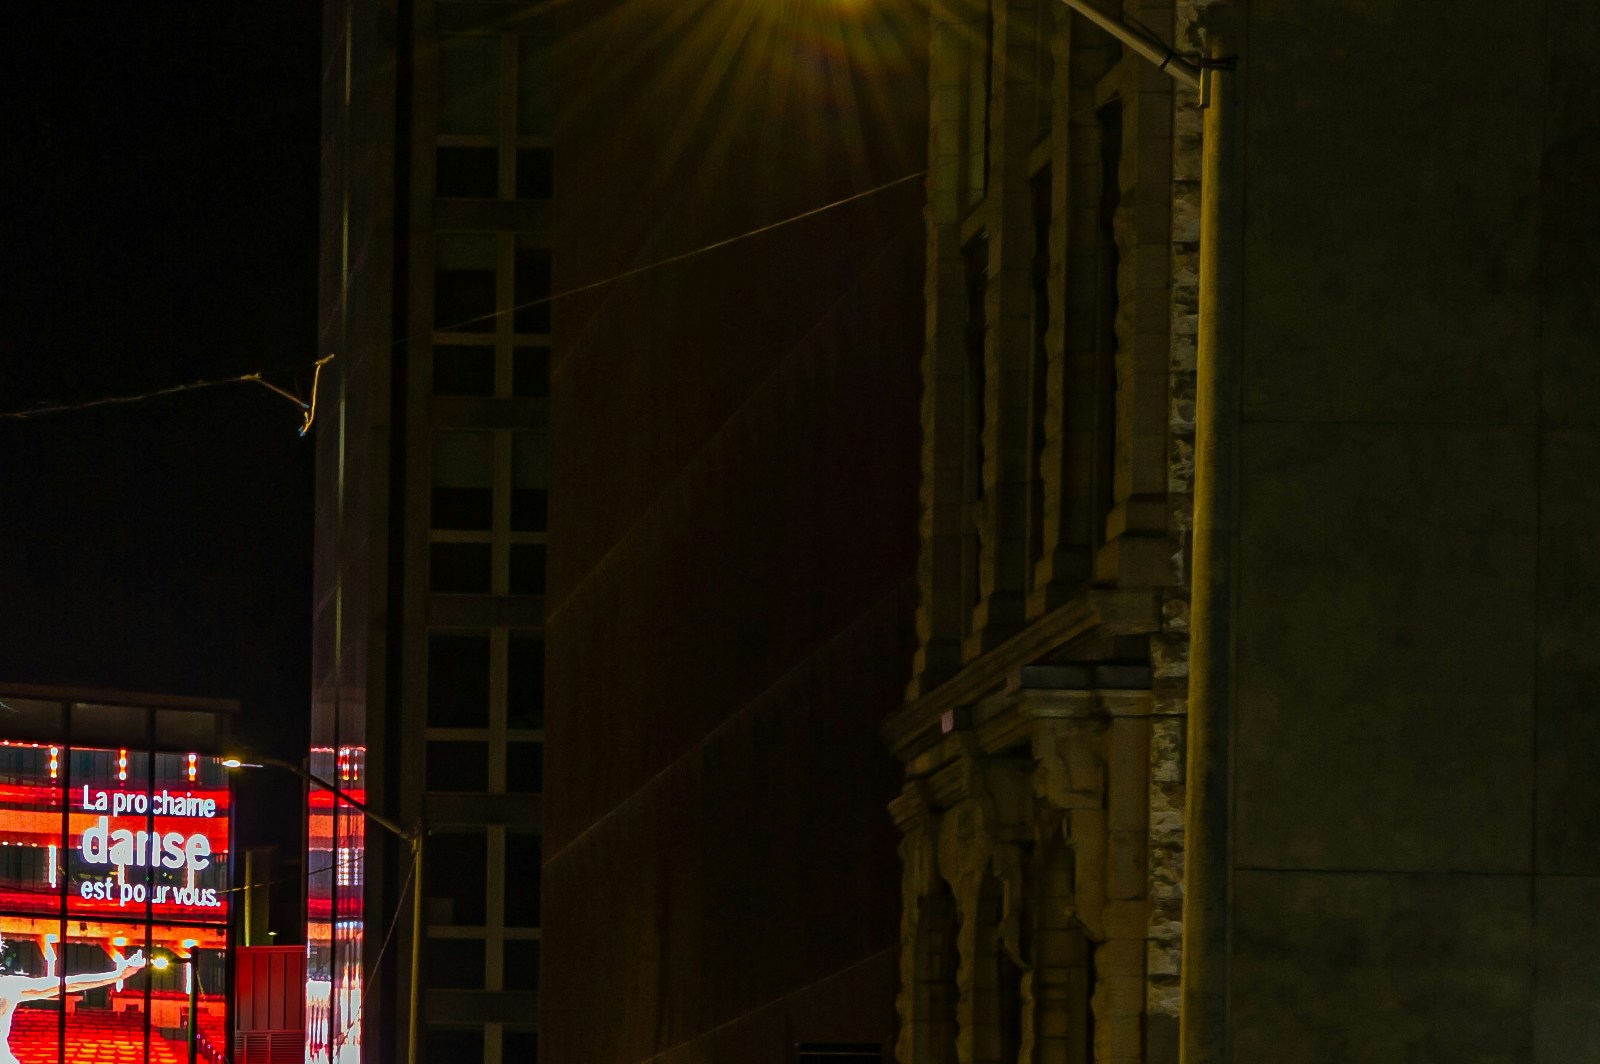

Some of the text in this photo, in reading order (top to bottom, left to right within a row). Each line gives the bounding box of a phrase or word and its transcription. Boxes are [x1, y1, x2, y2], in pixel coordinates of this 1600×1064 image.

[83, 785, 108, 810] La
[82, 815, 210, 870] danse
[81, 877, 113, 900] est
[173, 886, 221, 907] vous.
